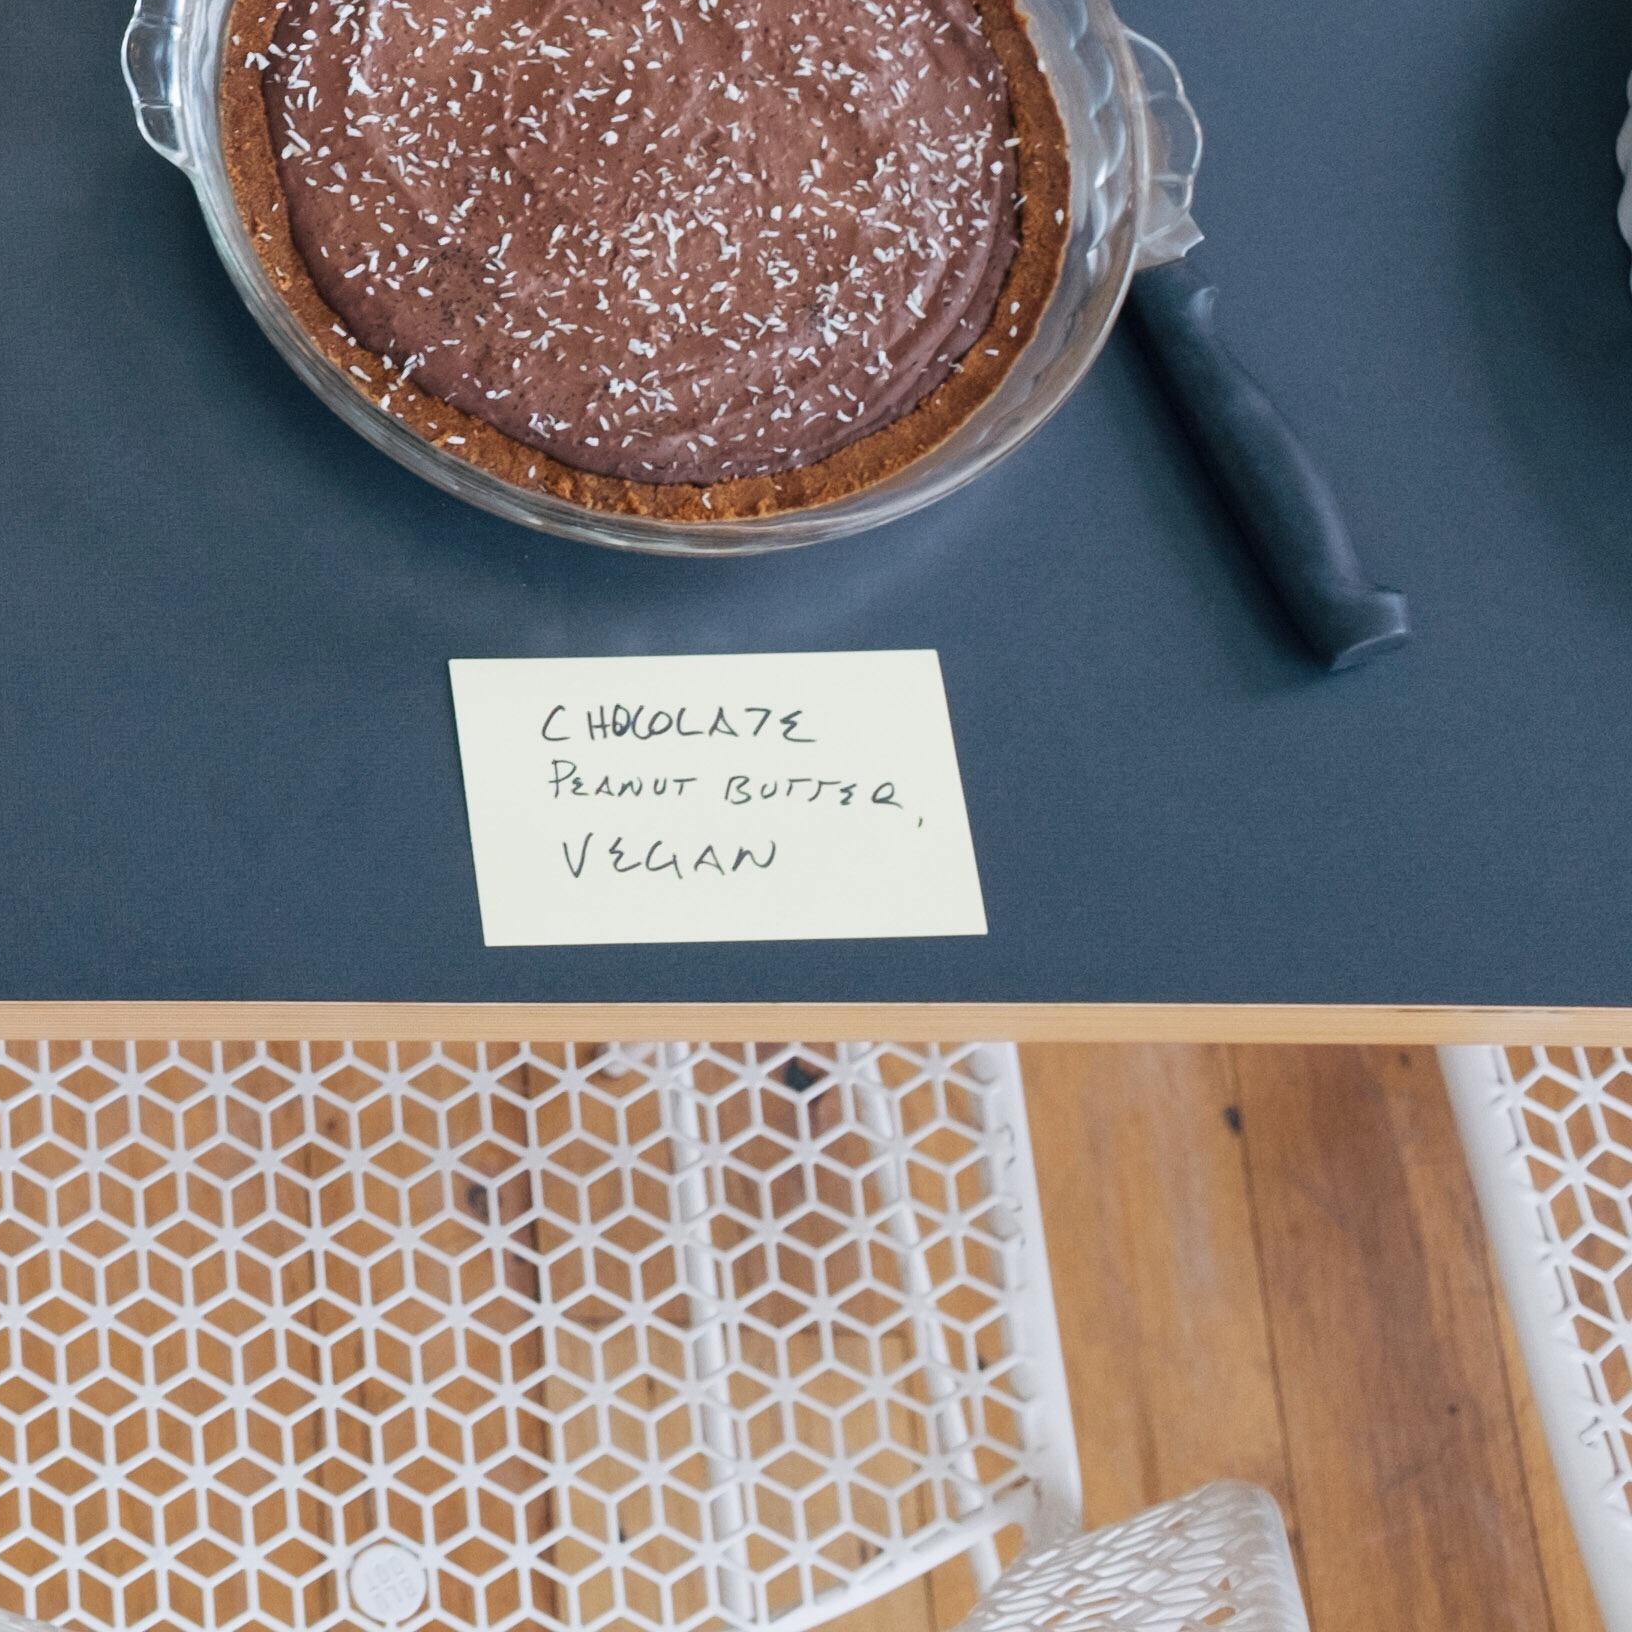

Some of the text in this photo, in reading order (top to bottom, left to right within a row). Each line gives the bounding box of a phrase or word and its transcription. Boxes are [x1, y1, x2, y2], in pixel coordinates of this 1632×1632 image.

[541, 704, 815, 743] CHOCOLATE
[548, 759, 697, 798] PEANUT
[562, 832, 776, 879] VEGAN
